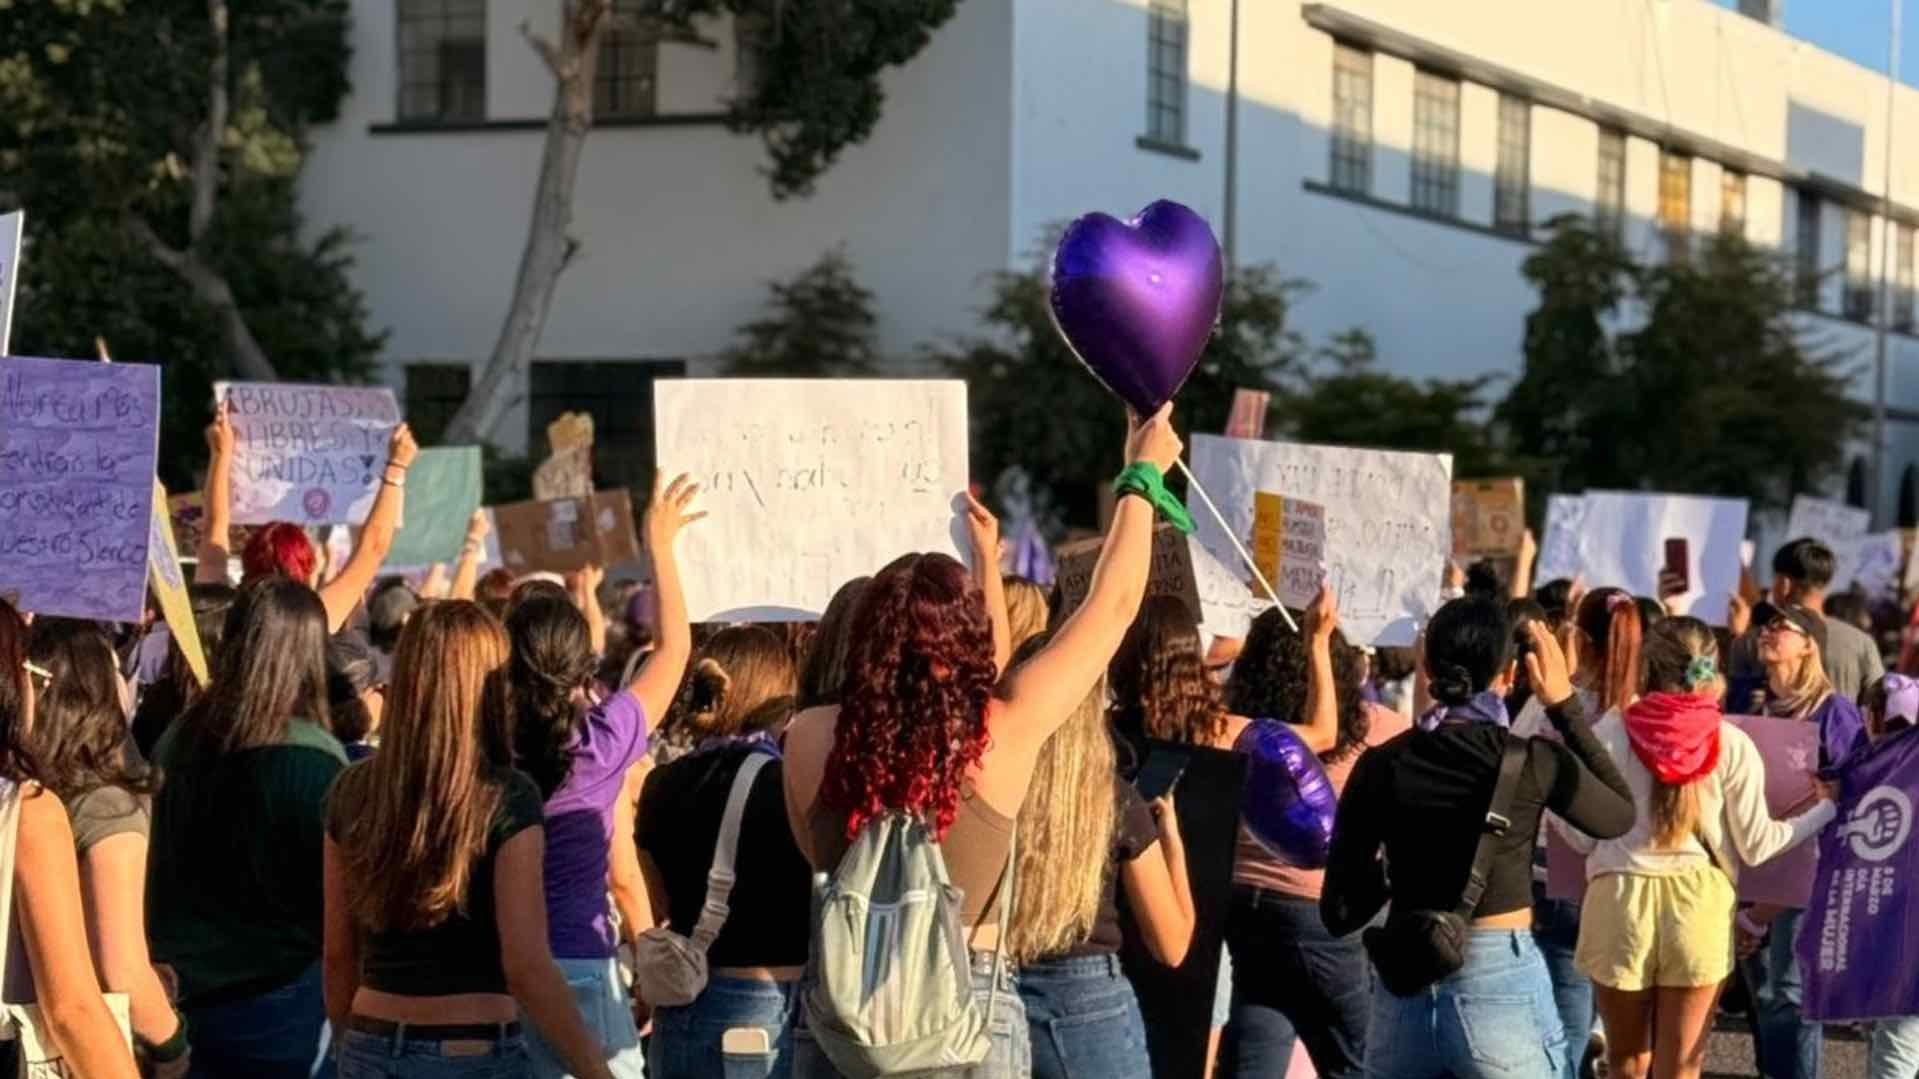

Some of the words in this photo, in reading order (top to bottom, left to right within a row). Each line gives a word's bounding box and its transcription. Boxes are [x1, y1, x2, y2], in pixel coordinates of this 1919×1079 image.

[245, 420, 347, 452] LIBRES
[1855, 868, 1869, 892] DÍA
[1884, 866, 1895, 875] 8
[1827, 889, 1838, 906] LA
[1867, 866, 1883, 915] MARZO
[1882, 877, 1894, 896] DE
[1836, 868, 1855, 973] INTERNACIONAL
[1819, 908, 1838, 973] MUJER
